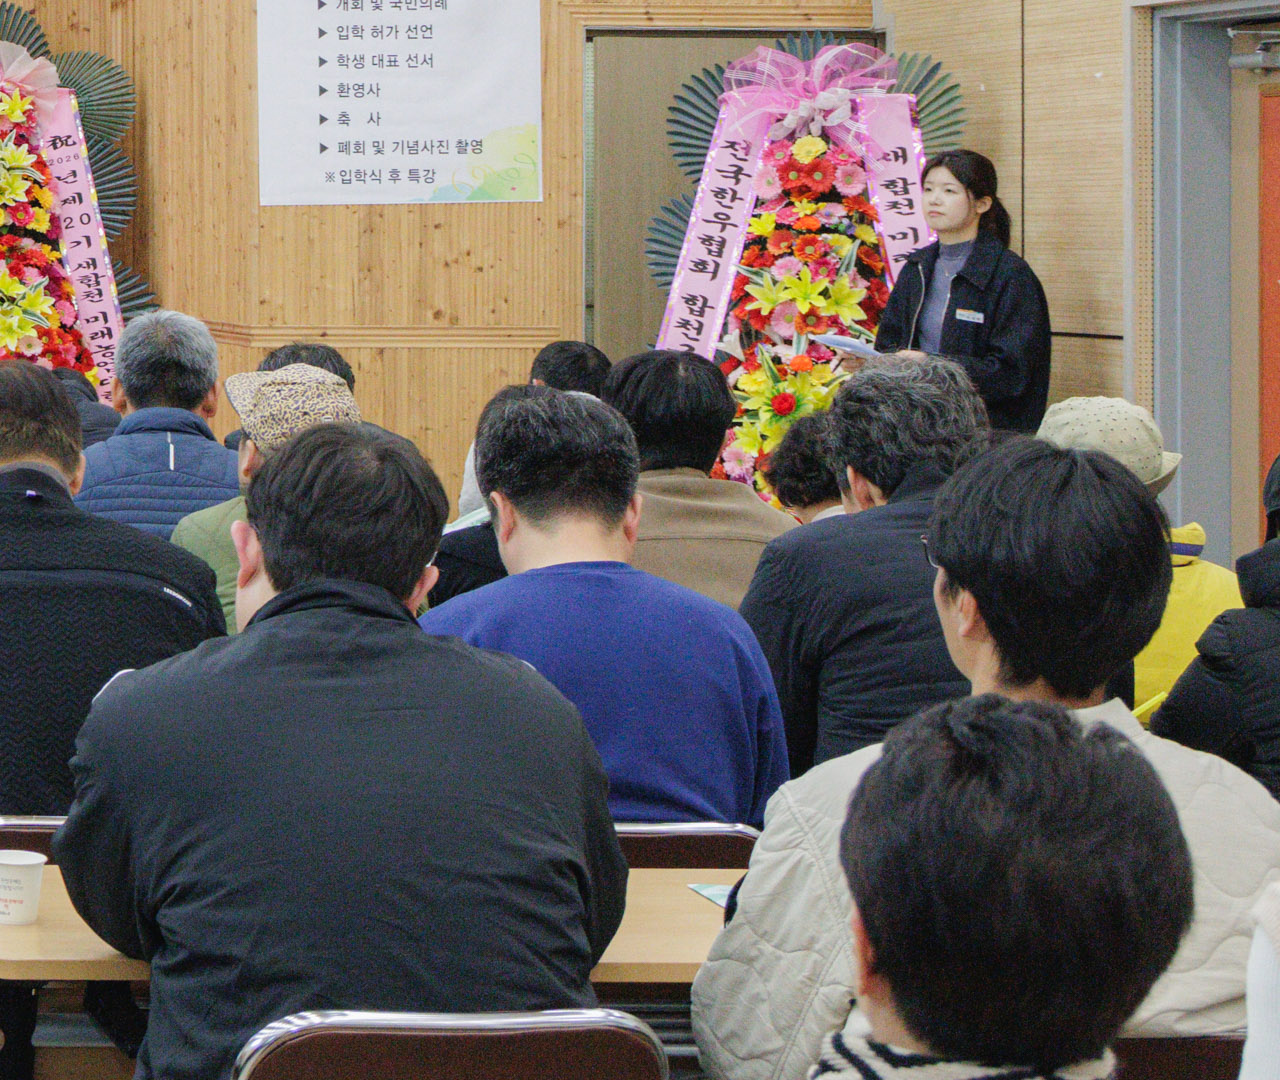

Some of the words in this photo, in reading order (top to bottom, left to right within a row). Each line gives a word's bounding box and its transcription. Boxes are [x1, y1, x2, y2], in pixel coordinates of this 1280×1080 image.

[336, 25, 365, 41] 입학
[370, 24, 400, 40] 허가
[405, 24, 433, 40] 선언
[337, 53, 365, 70] 학생
[371, 53, 400, 69] 대표
[405, 53, 433, 69] 선서
[336, 82, 381, 99] 환영사
[337, 111, 351, 127] 축
[367, 111, 382, 126] 사
[46, 134, 78, 151] 祝
[337, 140, 366, 156] 폐회
[372, 140, 385, 156] 및
[392, 139, 449, 155] 기념사진
[455, 138, 483, 155] 촬영
[387, 168, 402, 184] 후
[407, 168, 436, 184] 특강
[688, 139, 753, 281] 전국한우협회
